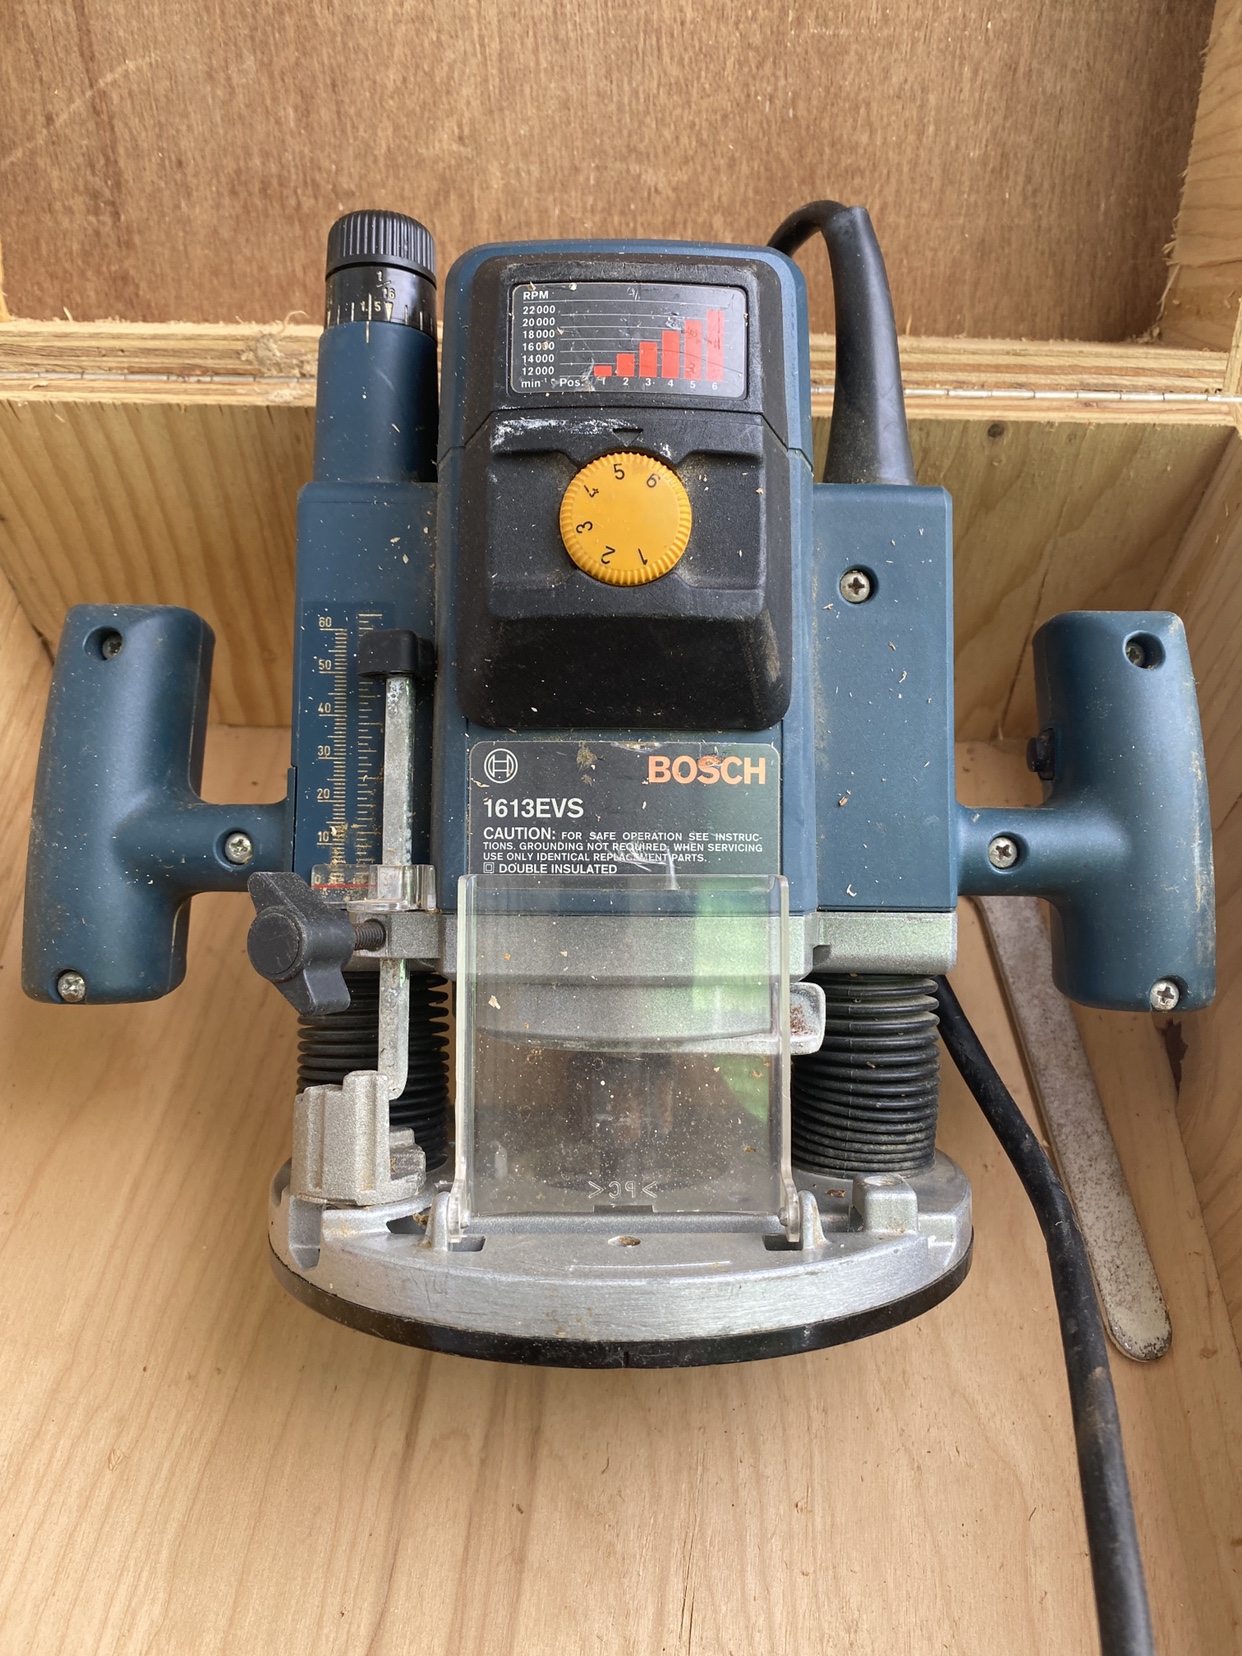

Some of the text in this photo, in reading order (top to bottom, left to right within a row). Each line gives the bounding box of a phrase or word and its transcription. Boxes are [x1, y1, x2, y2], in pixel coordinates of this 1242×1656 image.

[523, 291, 549, 300] RPM
[560, 378, 584, 387] Pos.
[623, 377, 629, 386] 2
[645, 378, 652, 386] 3
[668, 378, 674, 387] 4
[690, 380, 696, 389] 5
[712, 382, 718, 390] 6
[613, 463, 625, 480] 5
[646, 473, 661, 488] 6
[584, 484, 599, 498] 4
[575, 521, 593, 534] 3
[600, 546, 616, 565] 2
[637, 548, 648, 566] 1
[319, 616, 332, 628] 60
[318, 659, 332, 670] 50
[317, 702, 331, 713] 40
[317, 745, 331, 756] 30
[648, 755, 766, 785] BOSCH
[316, 788, 330, 799] 20
[483, 797, 584, 818] 1613EVS
[318, 831, 330, 842] 10
[483, 826, 763, 842] CAUTION: FOR SAFE OPERATION SEE INSTRUC-
[483, 841, 516, 850] TIONS.
[519, 842, 584, 851] GROUNDING
[587, 842, 609, 851] NOT
[673, 843, 704, 852] WHEN
[707, 843, 763, 852] SERVICING
[483, 852, 503, 861] USE
[506, 852, 534, 861] ONLY
[537, 852, 590, 861] IDENTICAL
[671, 853, 708, 862] PARTS.
[499, 863, 618, 874] DOUBLE INSULATED
